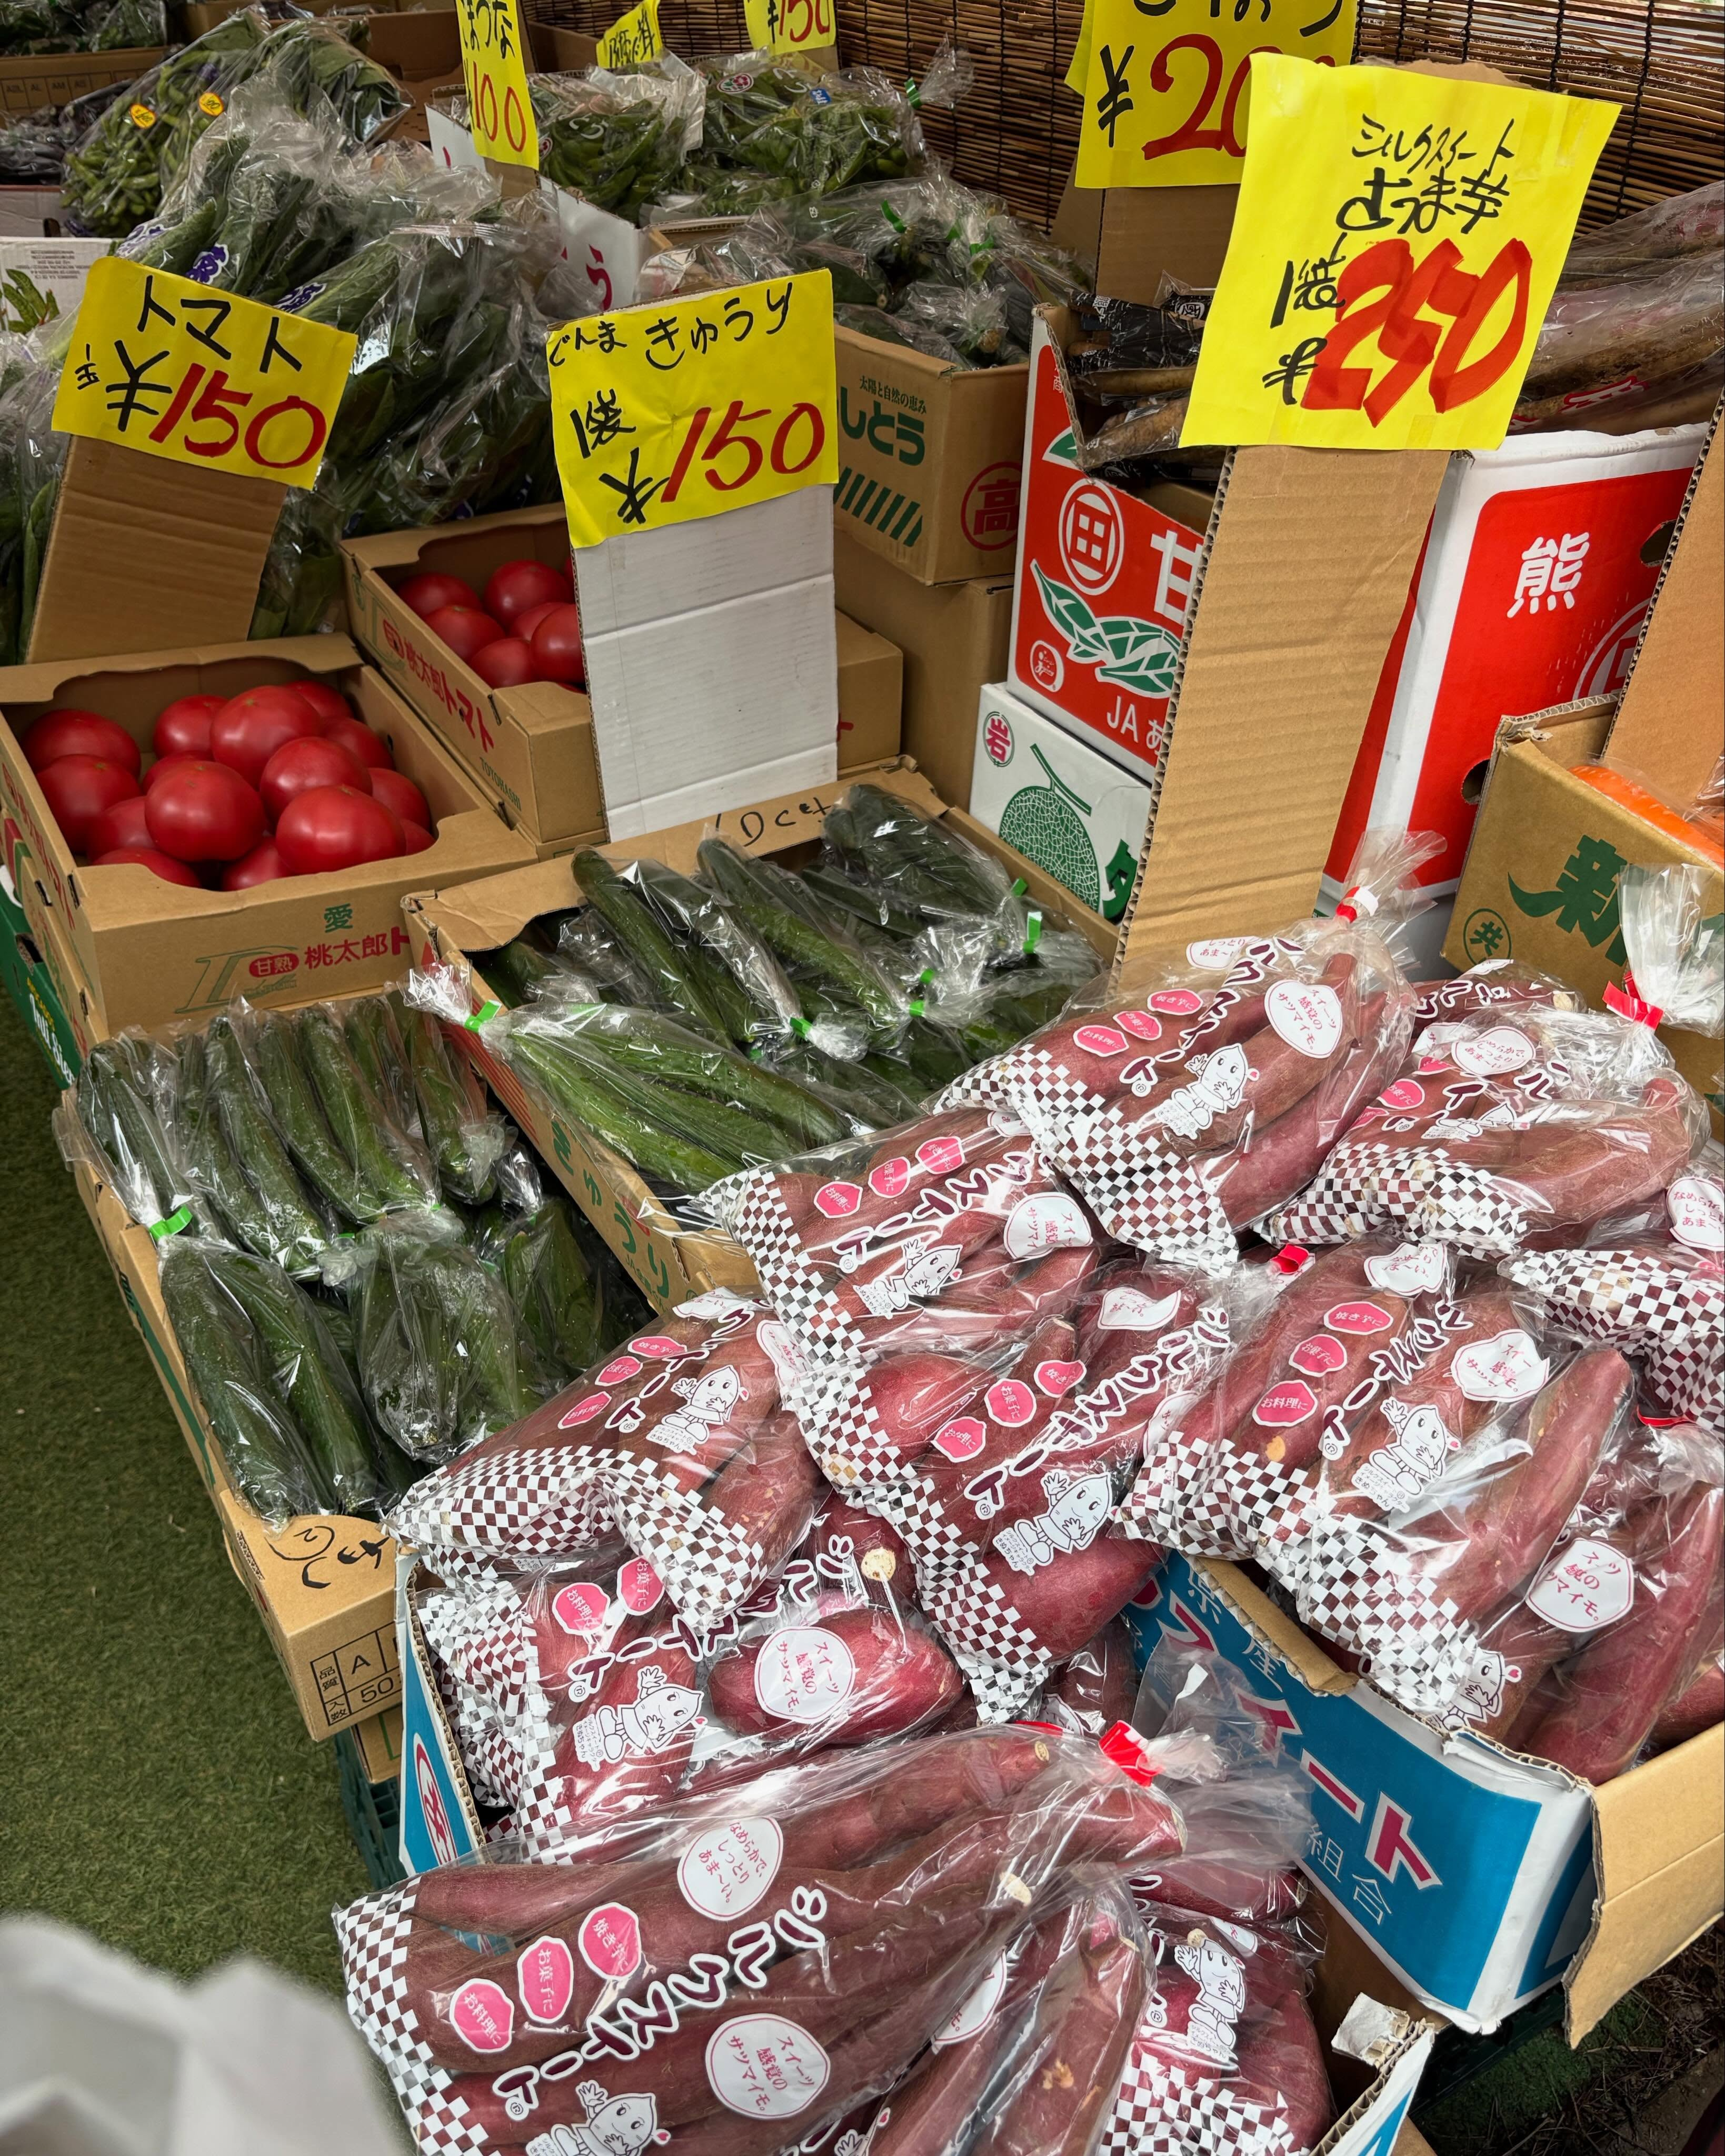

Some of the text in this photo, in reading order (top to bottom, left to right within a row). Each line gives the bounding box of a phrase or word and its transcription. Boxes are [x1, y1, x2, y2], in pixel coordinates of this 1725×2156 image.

[1352, 113, 1514, 174] シルクスイート
[1336, 166, 1510, 235] さつま芋
[137, 275, 302, 374] トマト
[549, 282, 793, 371] ぐんま きゅうり
[1263, 237, 1532, 428] ¥250
[105, 340, 328, 470] ¥150
[859, 375, 926, 414] 太陽と自然の恵み
[837, 386, 925, 466] しとう
[599, 400, 826, 524] ¥150
[1507, 531, 1590, 618] 熊
[480, 756, 522, 812] TOYOHASHI
[324, 903, 353, 933] 愛
[256, 957, 293, 976] 甘熟
[1298, 996, 1323, 1030] 感覚の
[1311, 990, 1337, 1029] スイーツ
[1261, 1396, 1309, 1411] お料理に
[995, 1537, 1019, 1568] きぬちゃん
[635, 1560, 651, 1608] お菓子に
[350, 1654, 371, 1675] A
[776, 1640, 800, 1713] サツマイモ。
[795, 1652, 817, 1694] 感覚の
[813, 1641, 840, 1693] スイーツ
[328, 1700, 349, 1724] 入数
[576, 1723, 588, 1759] きぬちゃん
[717, 1838, 750, 1884] しっとり
[537, 1948, 556, 2012] お菓子に
[463, 1992, 502, 2045] お料理に
[726, 2034, 771, 2113] サツマイモ。
[756, 2045, 789, 2091] 感覚の
[776, 2034, 815, 2087] スイーツ
